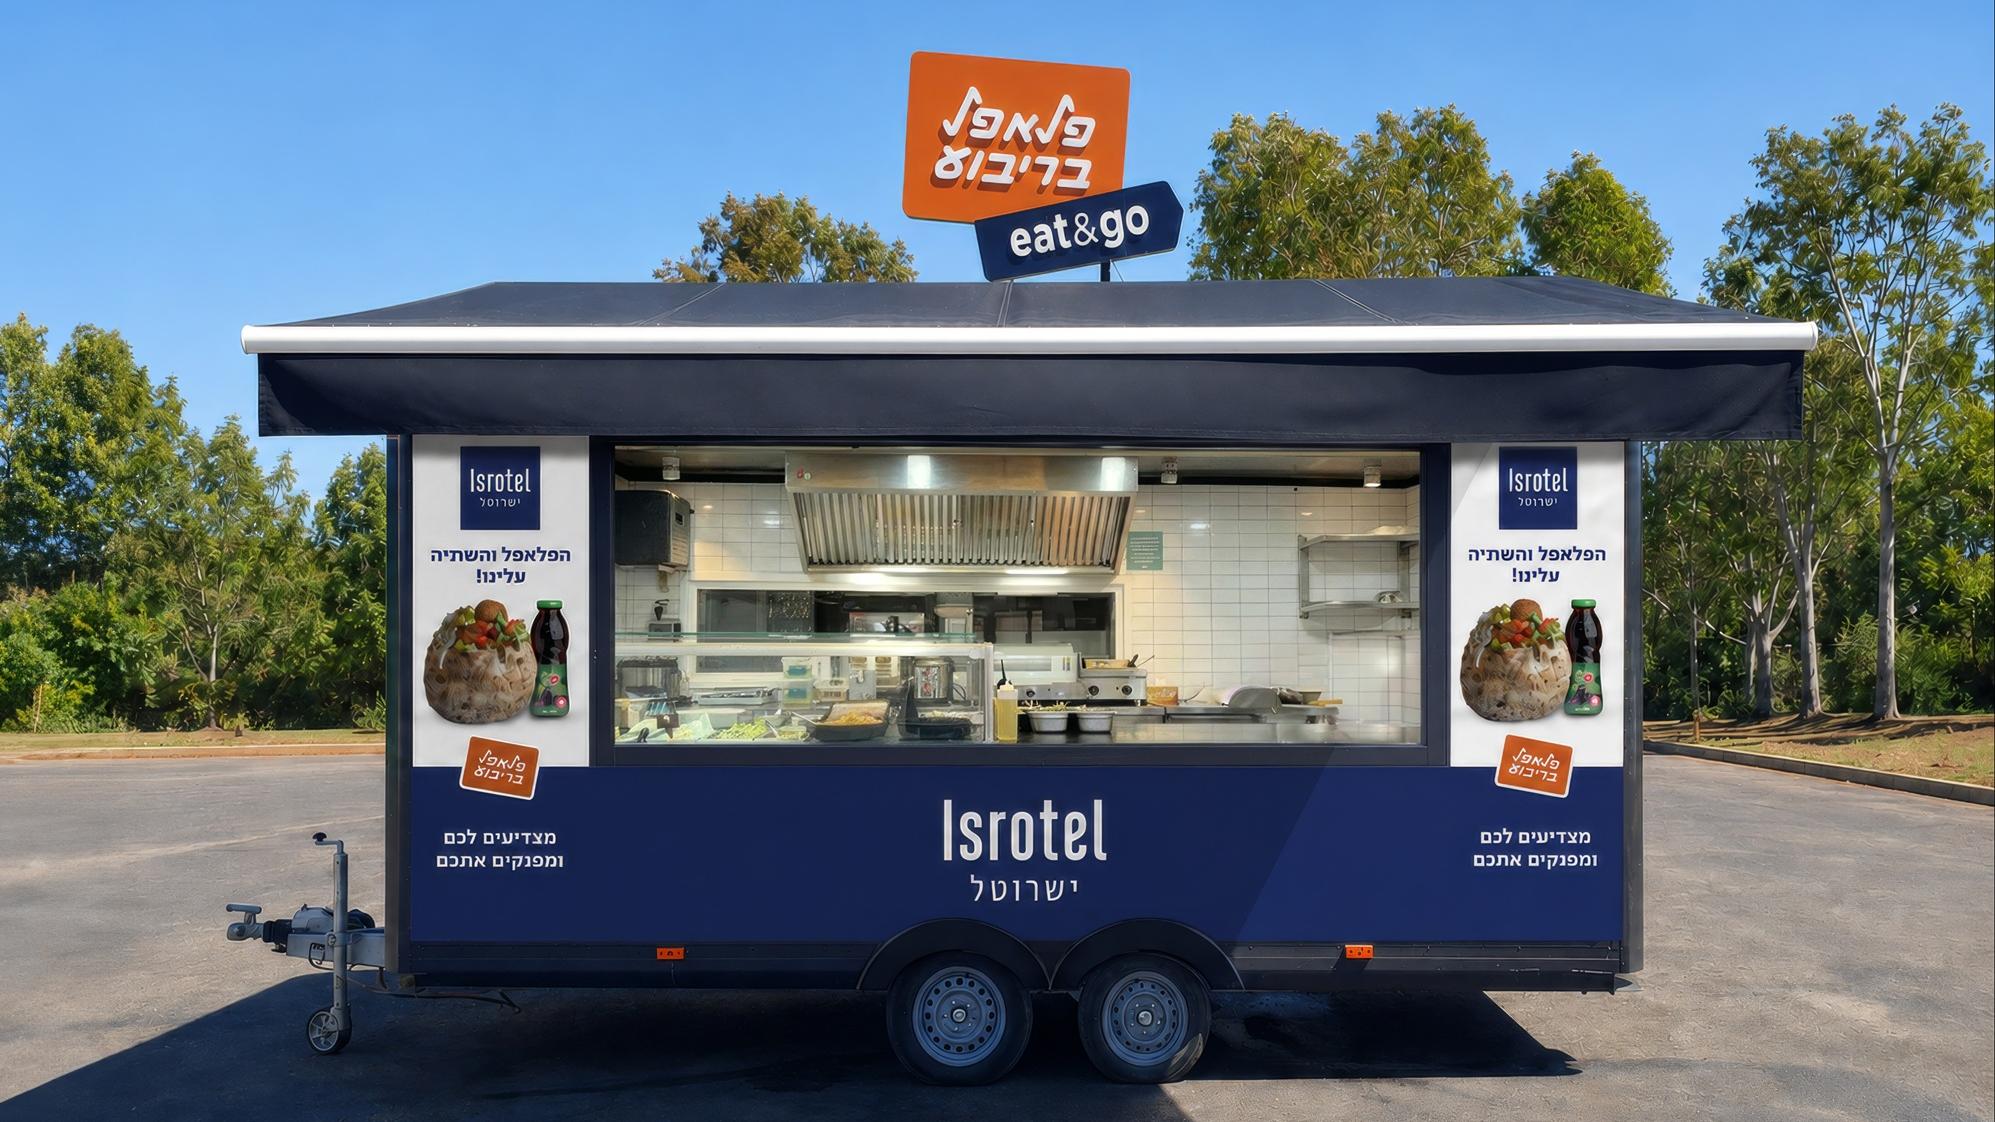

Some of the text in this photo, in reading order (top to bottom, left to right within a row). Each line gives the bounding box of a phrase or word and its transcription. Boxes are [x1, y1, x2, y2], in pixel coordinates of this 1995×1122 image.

[942, 86, 1096, 149] פלאפל
[934, 145, 1092, 189] בריבוע
[1010, 204, 1150, 257] eat&go
[470, 468, 531, 493] Isrotel
[1509, 467, 1568, 492] Isrotel
[431, 547, 571, 562] הפלאפל והשתיה
[1468, 546, 1606, 561] הפלאפל והשתיה
[476, 568, 526, 584] עלינו!
[1512, 567, 1560, 583] עלינו!
[479, 749, 526, 772] פלאפל
[1512, 747, 1560, 769] פלאפל
[474, 765, 524, 785] בריבוע
[1508, 763, 1557, 783] בריבוע
[444, 829, 556, 845] מצדיעים לכם
[943, 799, 1107, 861] Isrotel
[1480, 828, 1591, 844] מצדיעים לכם
[436, 855, 564, 871] ומפנקים אתכם
[1473, 854, 1597, 870] ומפנקים אתכם
[970, 874, 1078, 902] ישרוטל
